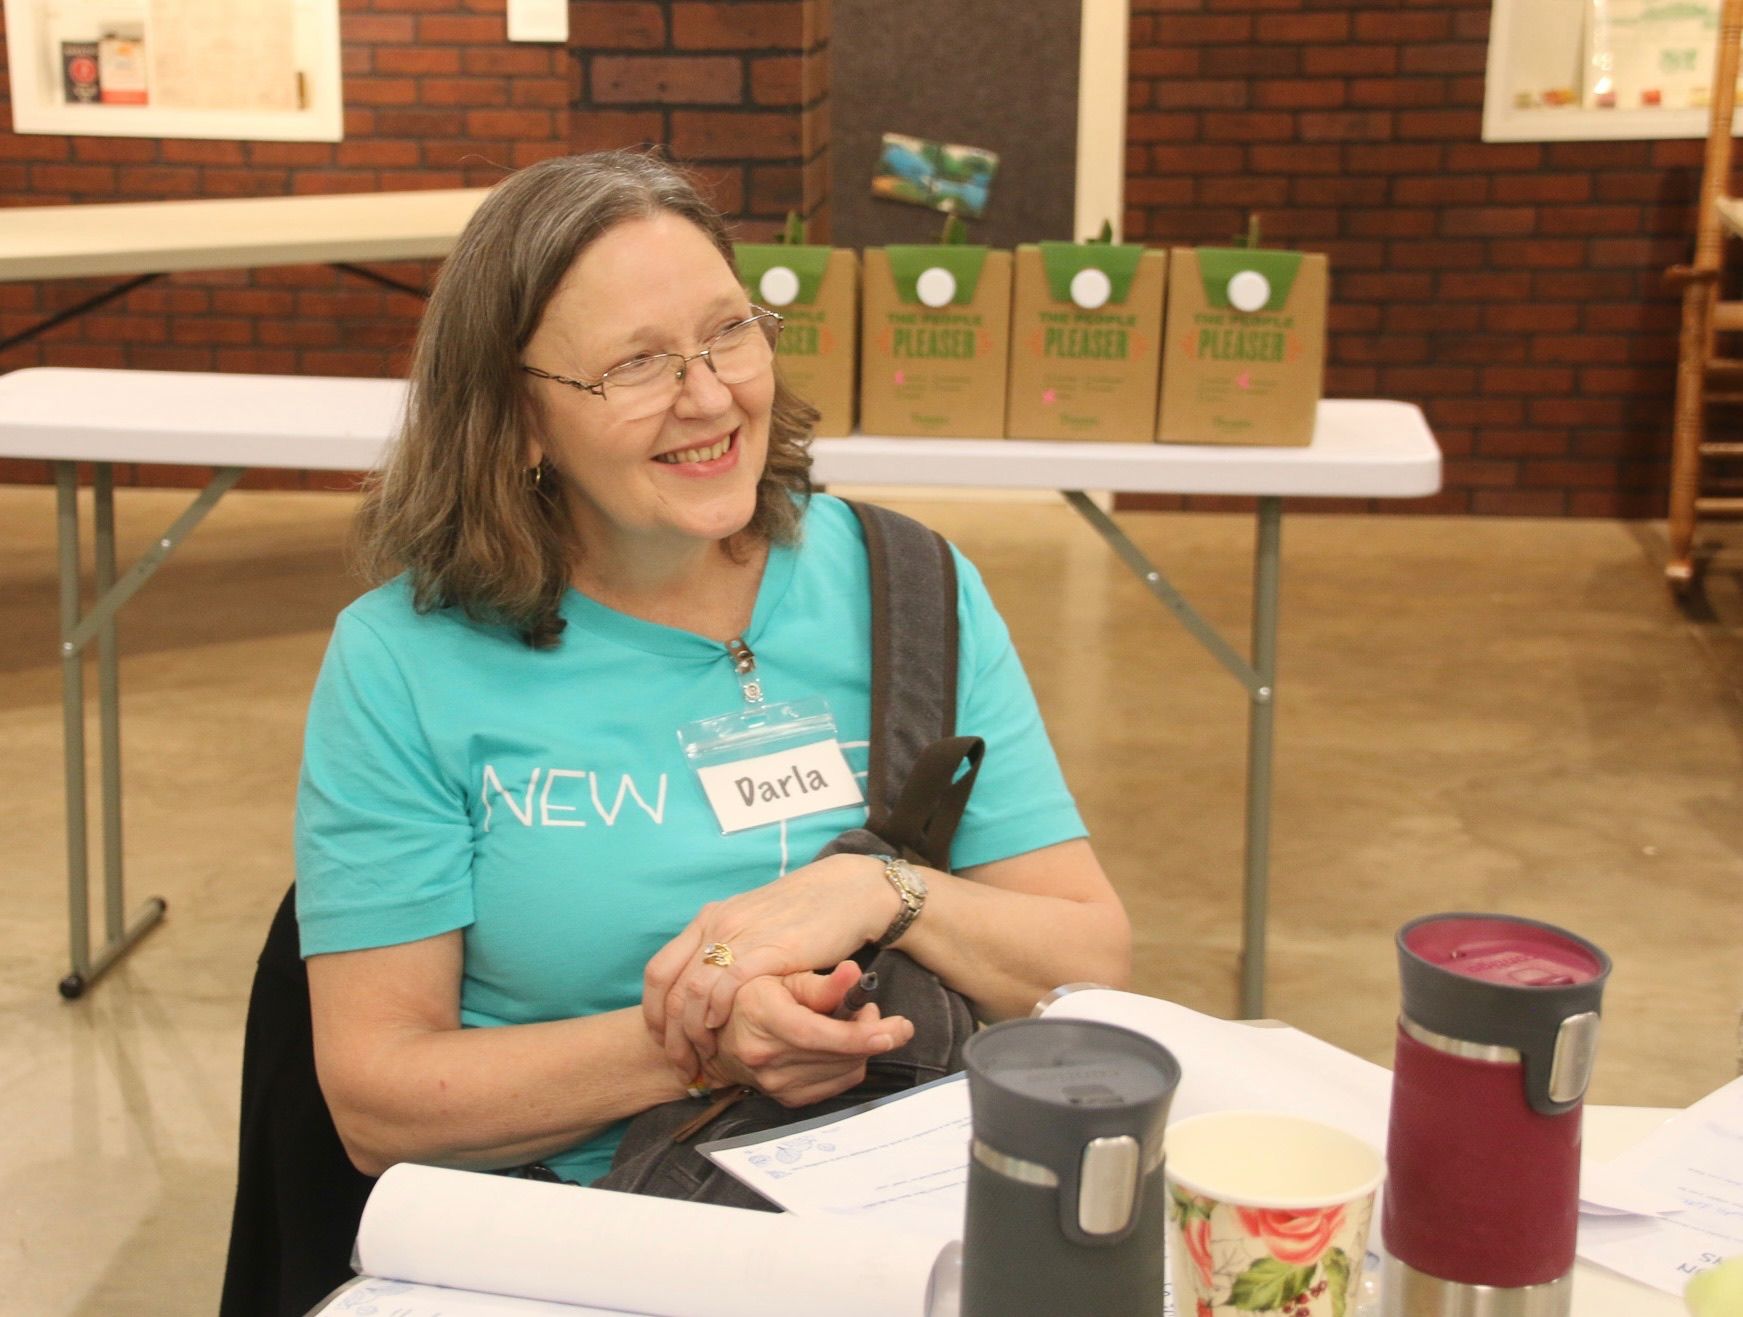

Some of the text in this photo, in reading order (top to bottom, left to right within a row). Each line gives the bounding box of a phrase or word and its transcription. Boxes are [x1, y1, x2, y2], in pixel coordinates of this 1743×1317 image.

[893, 328, 975, 359] PLEASER
[1044, 327, 1127, 359] PLEASER
[1199, 329, 1285, 362] PLEASER
[481, 764, 667, 832] NEW
[734, 765, 829, 807] Darla
